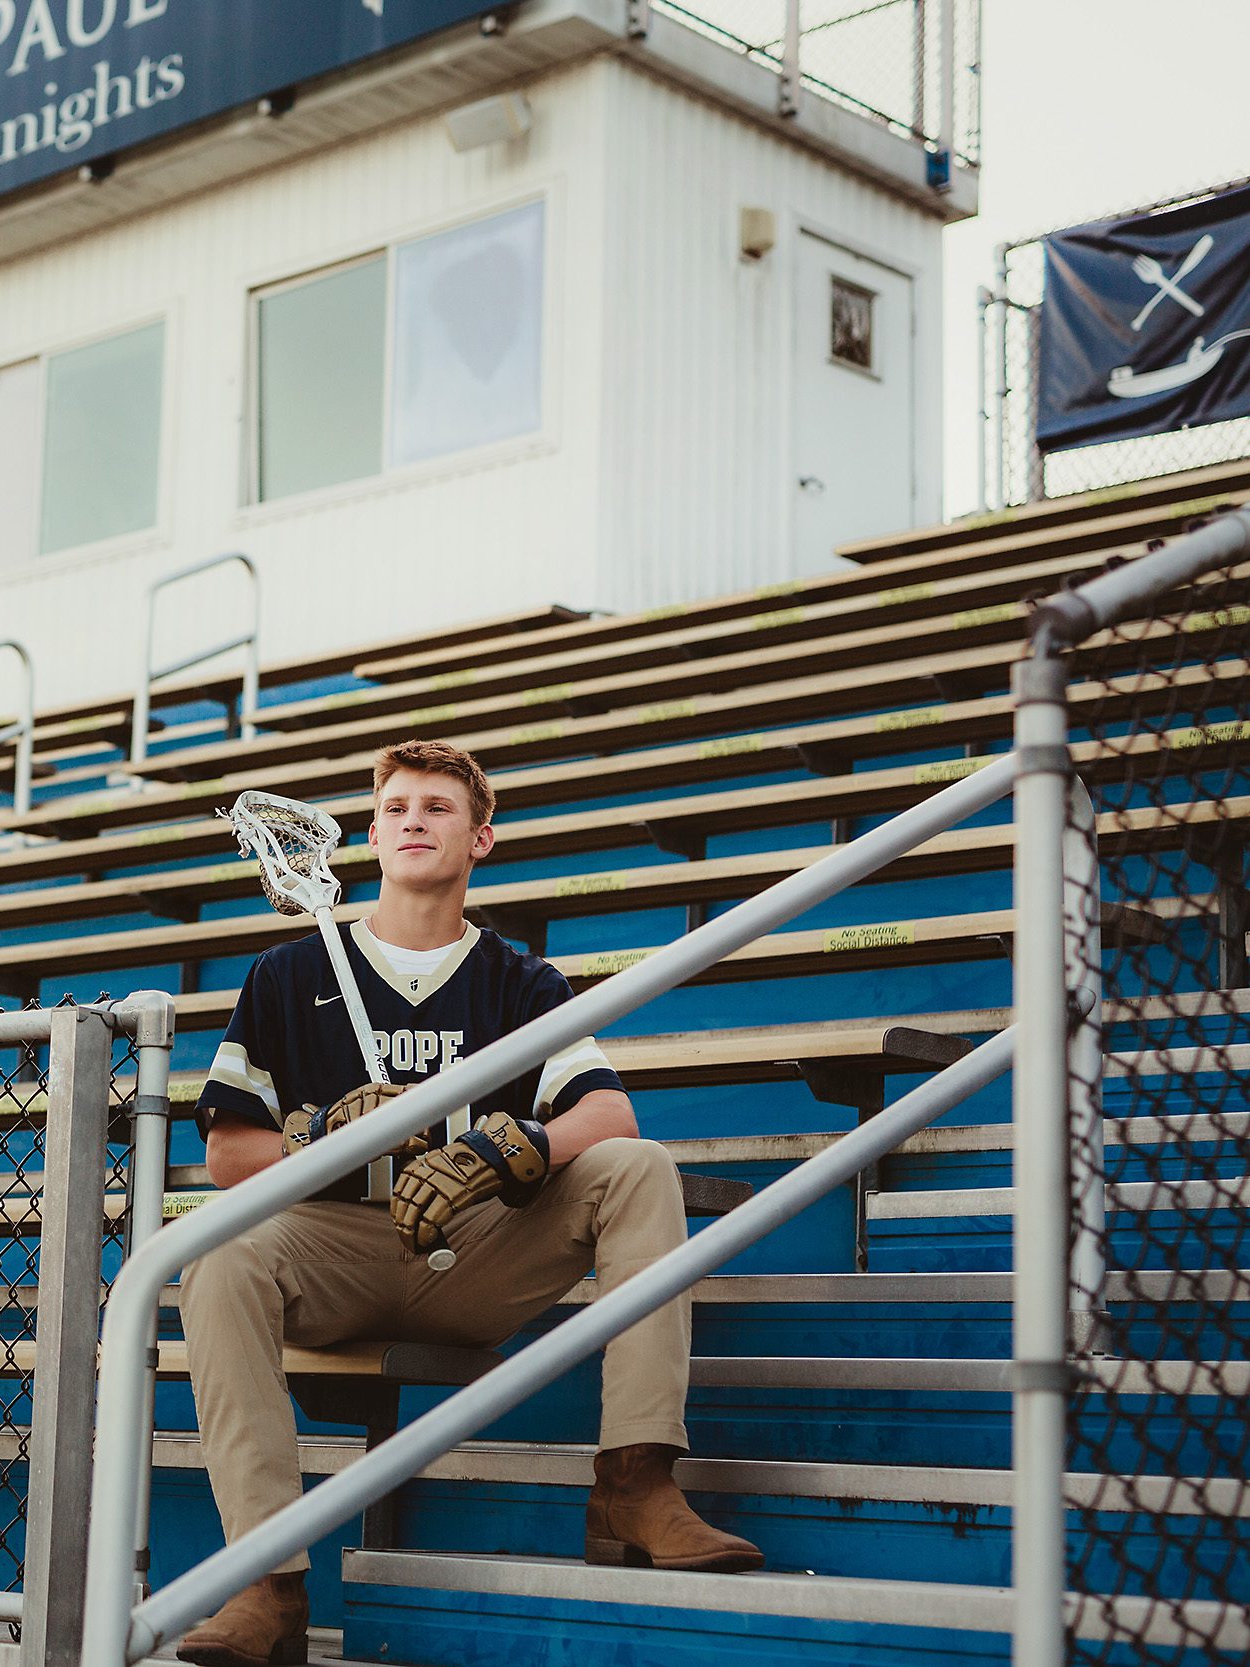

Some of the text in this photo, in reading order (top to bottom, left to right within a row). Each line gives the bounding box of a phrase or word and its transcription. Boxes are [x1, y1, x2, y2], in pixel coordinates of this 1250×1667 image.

[841, 926, 898, 939] No Seating
[830, 934, 908, 951] Social Distance
[597, 956, 610, 964] No
[372, 1029, 463, 1073] POPE
[173, 1194, 207, 1204] Seating
